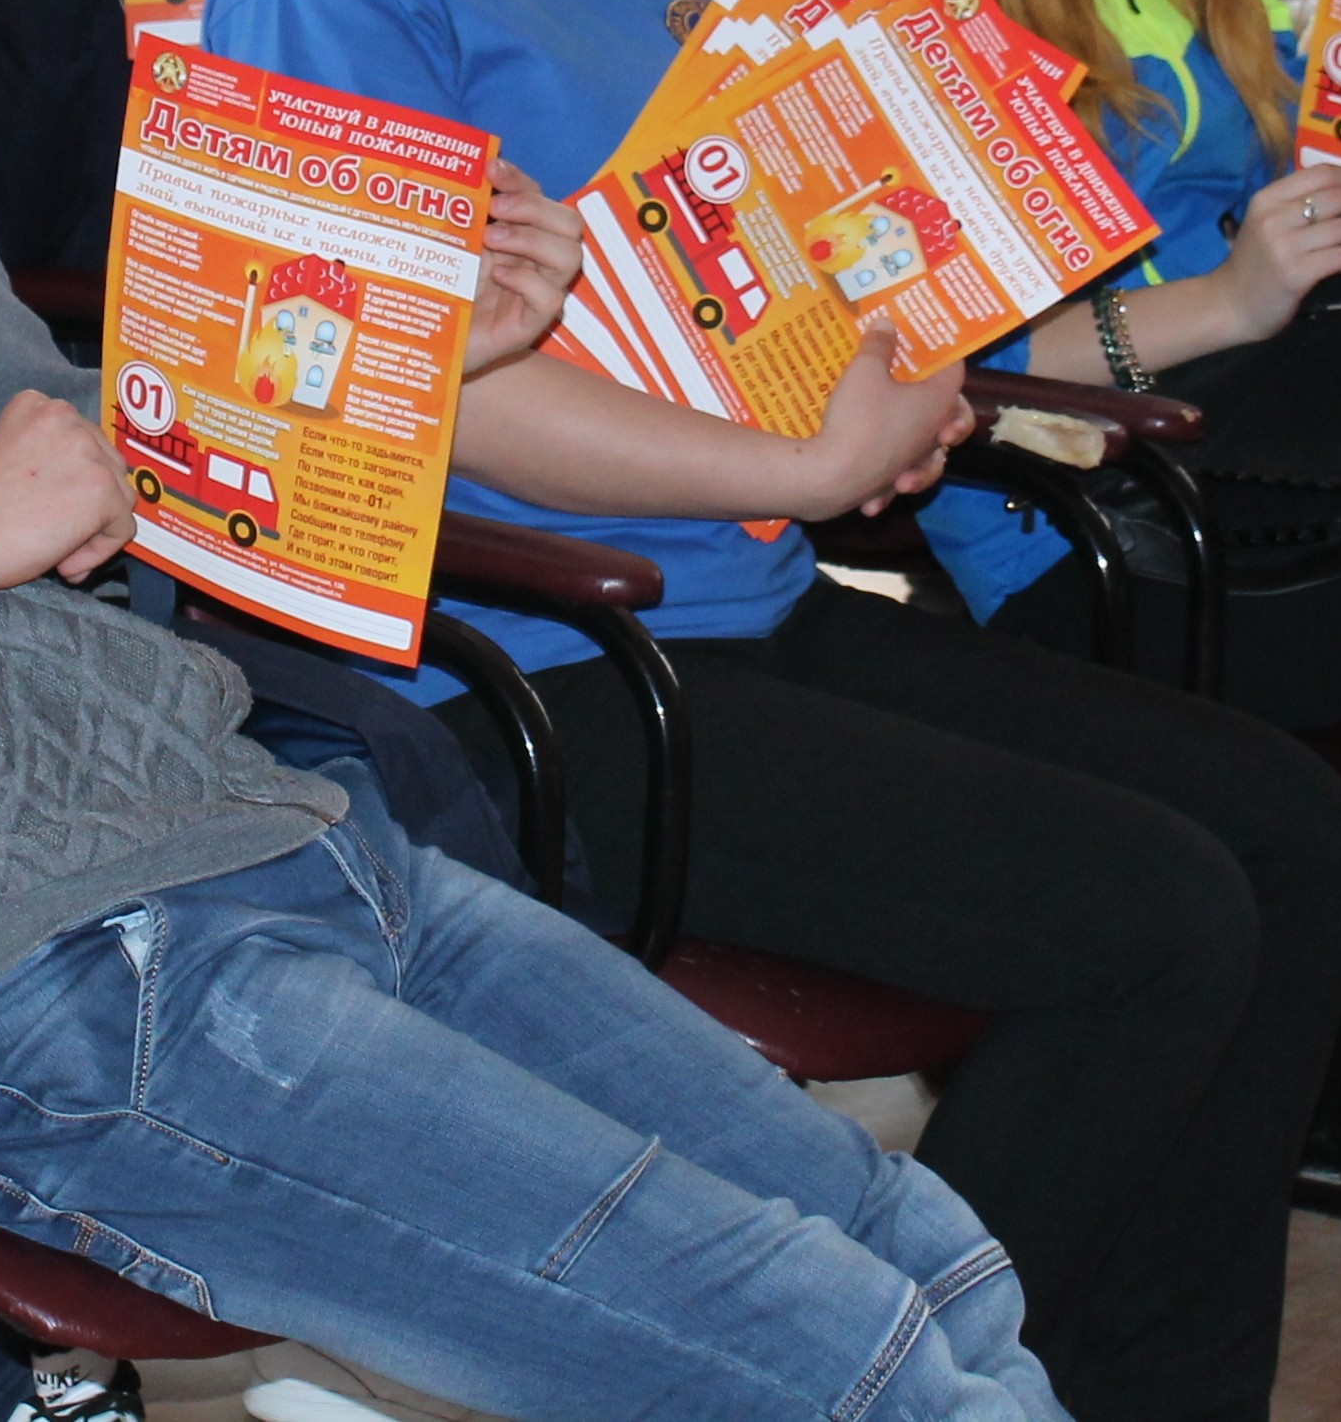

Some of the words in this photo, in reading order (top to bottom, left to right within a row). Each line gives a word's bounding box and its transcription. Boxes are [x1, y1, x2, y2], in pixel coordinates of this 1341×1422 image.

[268, 90, 362, 126] УЧАСТВУЙ
[365, 115, 379, 130] В
[382, 120, 481, 160] ДВИЖЕНИИ
[273, 109, 343, 140] "ЮНЫЙ
[348, 130, 472, 176] ПОЖАРНЫЙ"!
[892, 8, 1001, 141] Детям
[987, 137, 1044, 189] об
[1022, 187, 1094, 272] огне
[140, 97, 293, 178] Детям
[298, 154, 362, 195] об
[366, 172, 474, 228] огне
[698, 145, 740, 190] 01
[1017, 76, 1075, 148] УЧАСТВУЙ
[1068, 148, 1082, 160] В
[1075, 161, 1137, 232] ДВИЖЕНИИ
[136, 182, 178, 206] знай,
[184, 200, 266, 234] выполняй
[273, 228, 296, 242] их
[302, 236, 312, 247] и
[319, 241, 380, 266] помни,
[387, 255, 460, 287] дружок!
[138, 160, 203, 195] Правил
[210, 188, 310, 227] пожарных
[317, 220, 406, 257] несложен
[413, 246, 462, 270] урок:
[126, 374, 163, 420] 01
[300, 442, 324, 458] Если
[327, 452, 360, 468] что-то
[362, 462, 415, 484] загорится,
[302, 426, 327, 442] Если
[330, 436, 363, 452] что-то
[365, 445, 424, 469] задымится,
[295, 475, 346, 499] Позвоним
[348, 493, 361, 503] по
[298, 459, 311, 472] По
[314, 466, 355, 485] тревоге,
[358, 479, 375, 489] как
[290, 508, 337, 532] Сообщим
[339, 526, 352, 536] по
[355, 529, 405, 552] телефону
[292, 492, 311, 506] Мы
[312, 499, 380, 528] ближайшему
[381, 519, 418, 538] району
[286, 542, 294, 551] И
[296, 547, 312, 559] кто
[314, 553, 326, 564] об
[328, 557, 353, 571] этом
[354, 564, 398, 582] говорит!
[288, 524, 305, 540] Где
[307, 533, 335, 548] горит,
[348, 546, 365, 557] что
[367, 550, 396, 564] горит,
